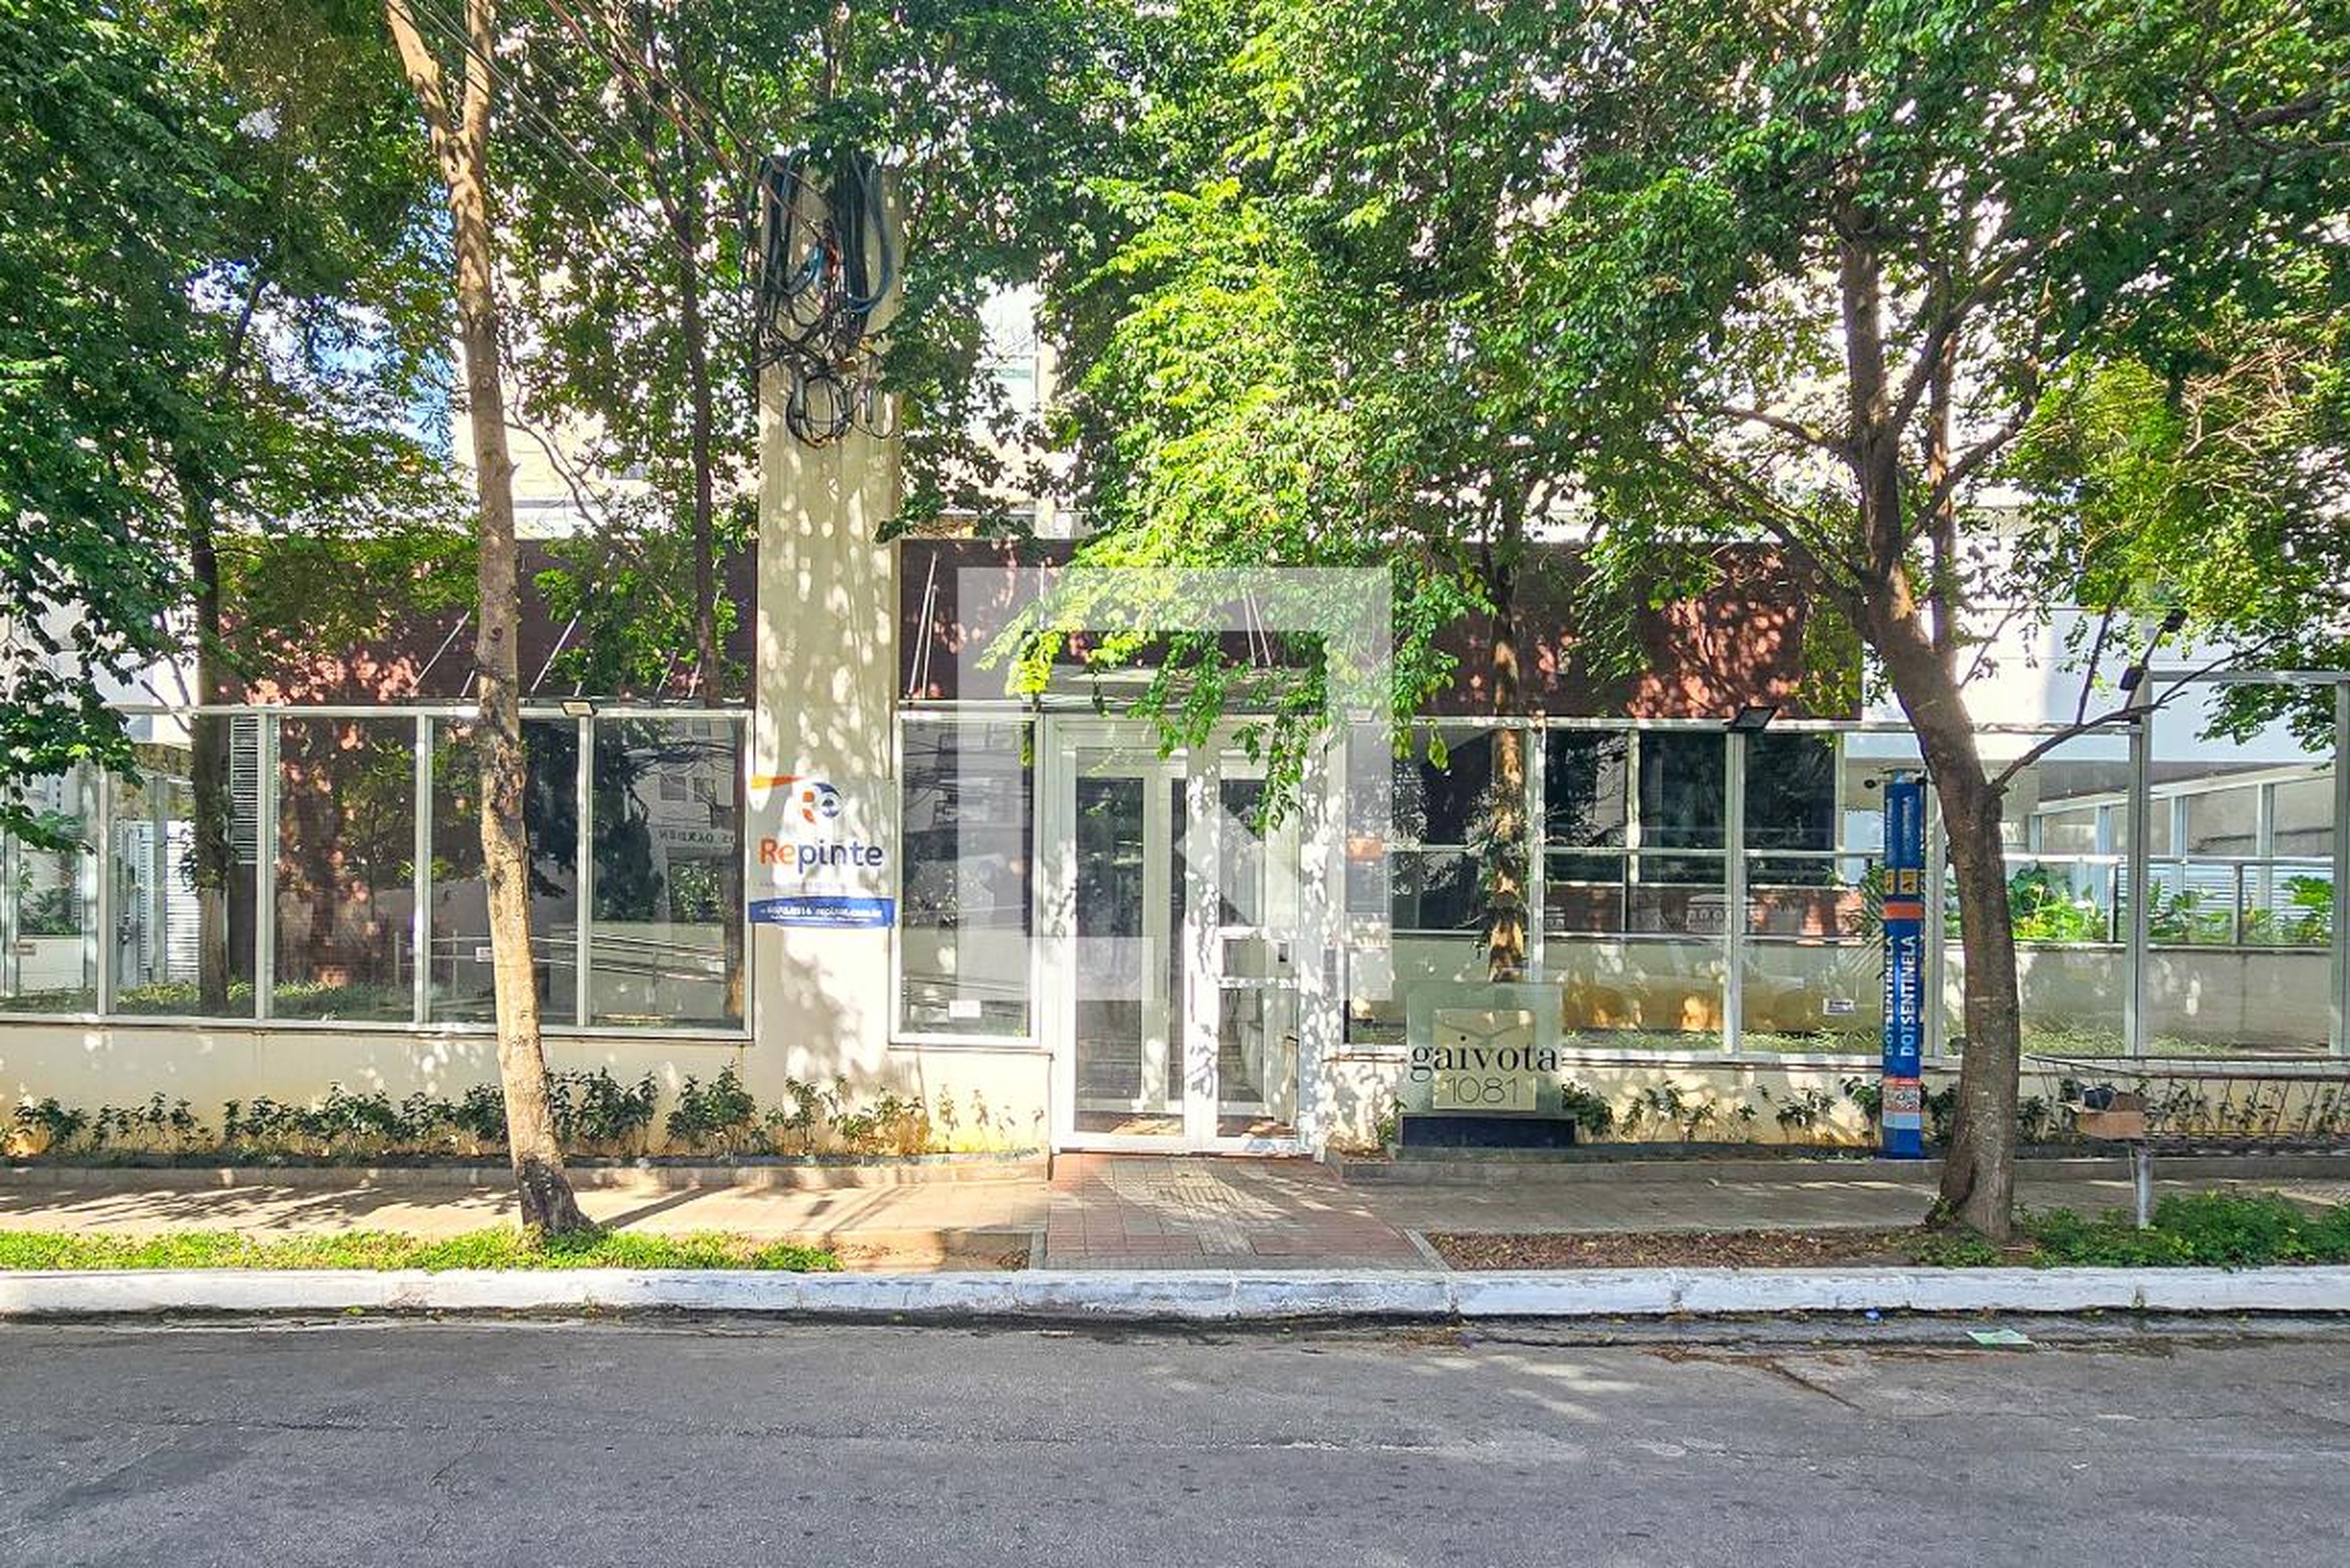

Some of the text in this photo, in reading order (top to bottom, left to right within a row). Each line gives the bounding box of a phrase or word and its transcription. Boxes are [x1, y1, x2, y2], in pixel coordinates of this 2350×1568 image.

[759, 837, 883, 875] Repinte
[1900, 935, 1917, 1057] DOTSENTINELA
[1409, 1035, 1561, 1083] gaivota
[1445, 1076, 1518, 1103] 1081
